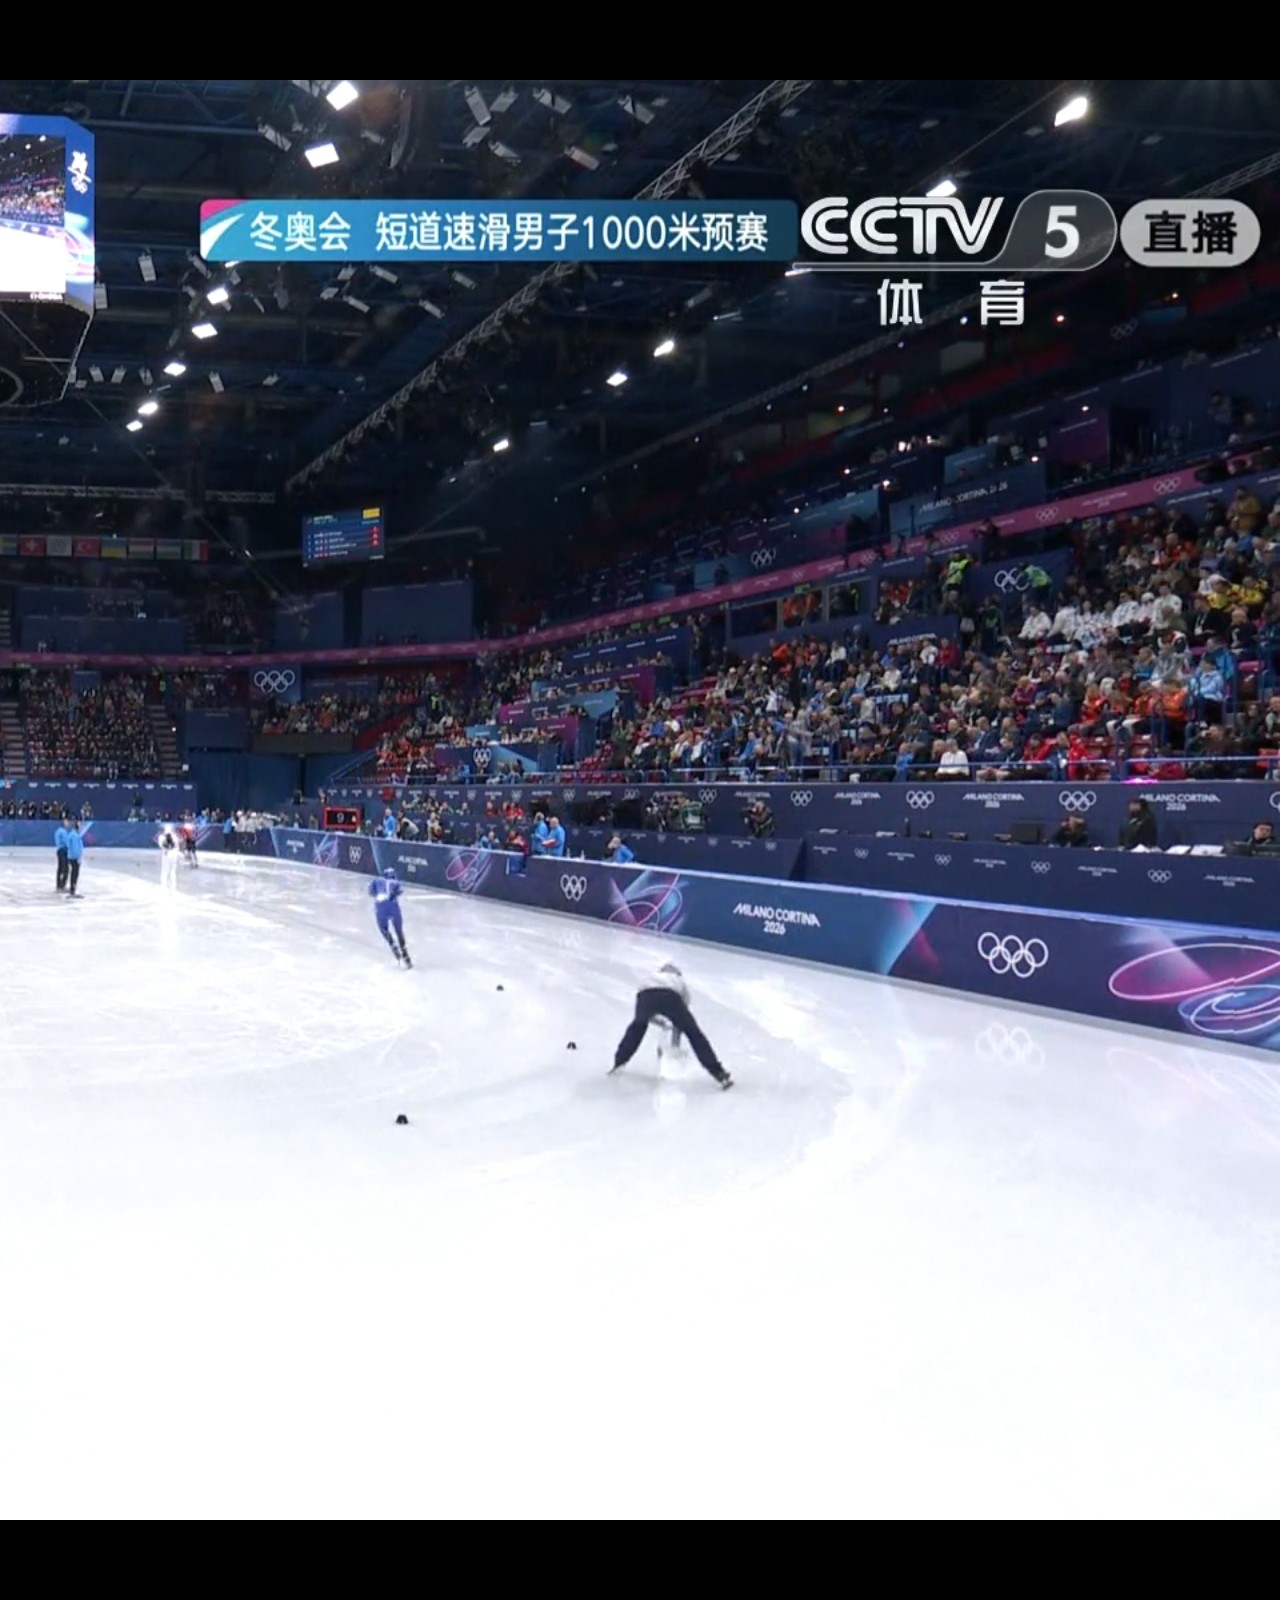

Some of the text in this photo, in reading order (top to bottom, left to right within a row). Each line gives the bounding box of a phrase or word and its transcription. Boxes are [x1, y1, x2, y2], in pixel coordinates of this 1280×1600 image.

[733, 902, 821, 928] MILANO CORTINA
[763, 920, 786, 935] 2026
